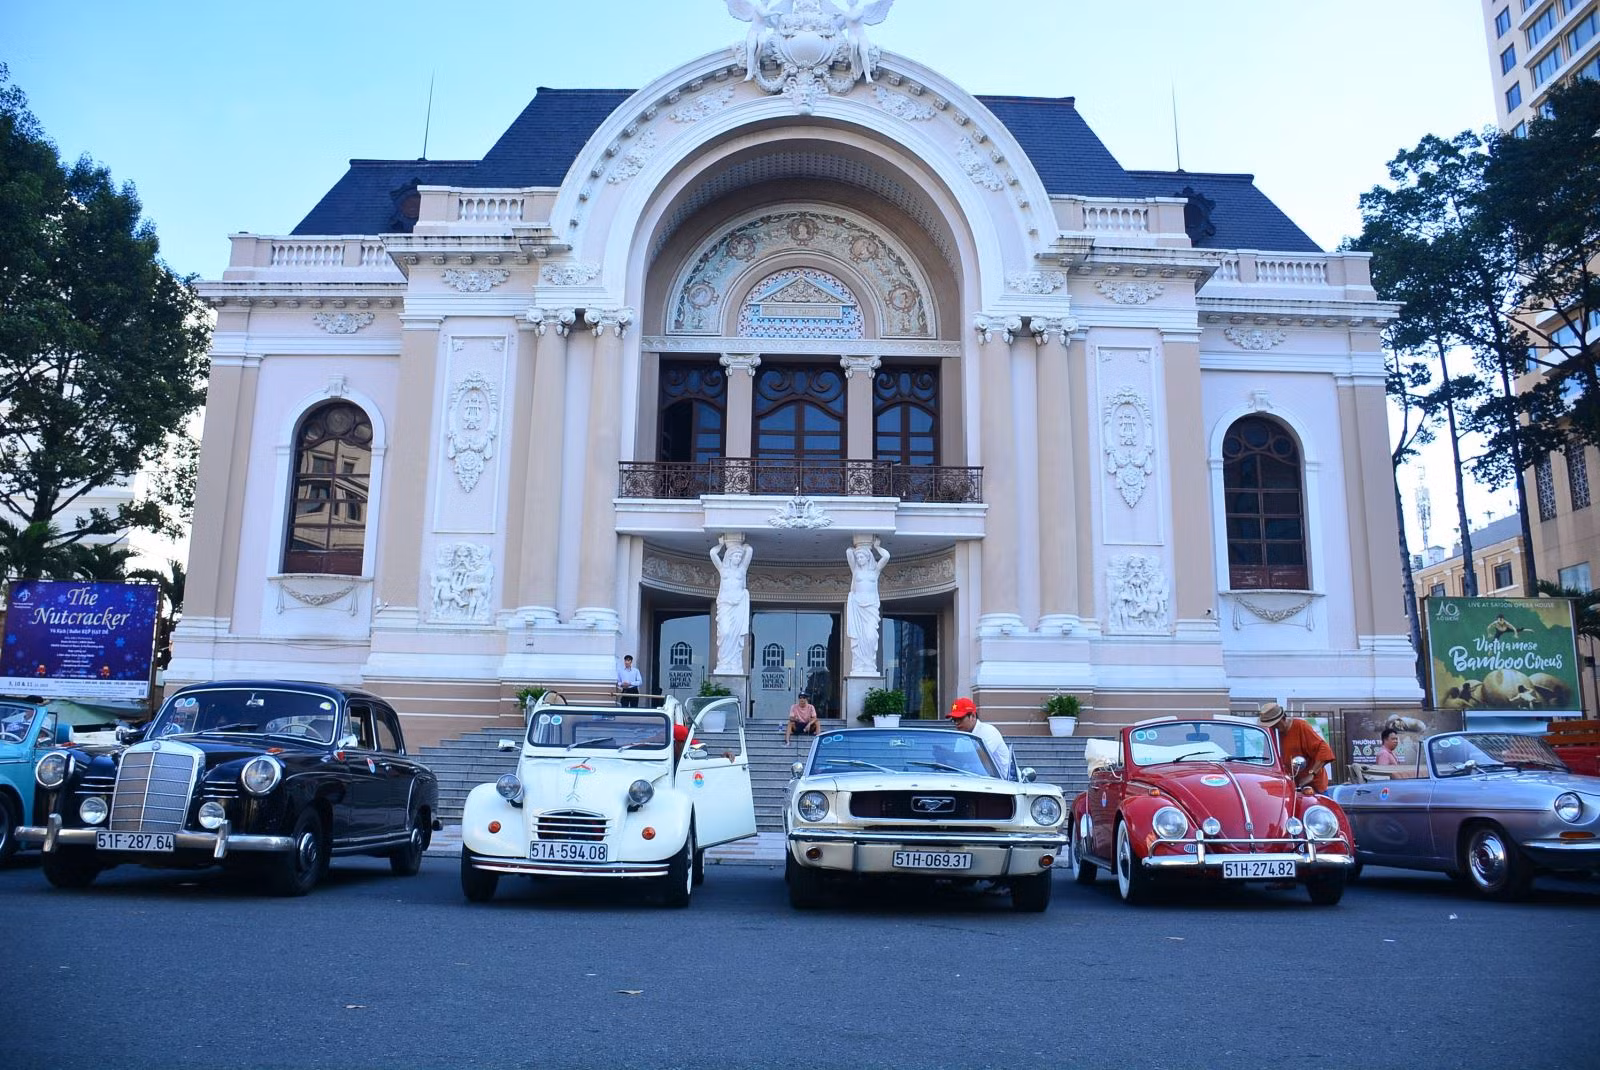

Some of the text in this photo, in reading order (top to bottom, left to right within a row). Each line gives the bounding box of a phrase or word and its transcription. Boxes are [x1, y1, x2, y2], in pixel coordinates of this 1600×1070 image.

[67, 586, 98, 606] The
[32, 607, 130, 630] Nutcracker
[1472, 635, 1538, 653] Vietnamese
[1448, 646, 1563, 672] Bamboo Circus
[98, 833, 173, 850] 51F-287.64
[531, 843, 606, 860] 51A-594.08
[896, 852, 968, 868] 51H-069.31
[1225, 862, 1294, 877] 51H-274.82
